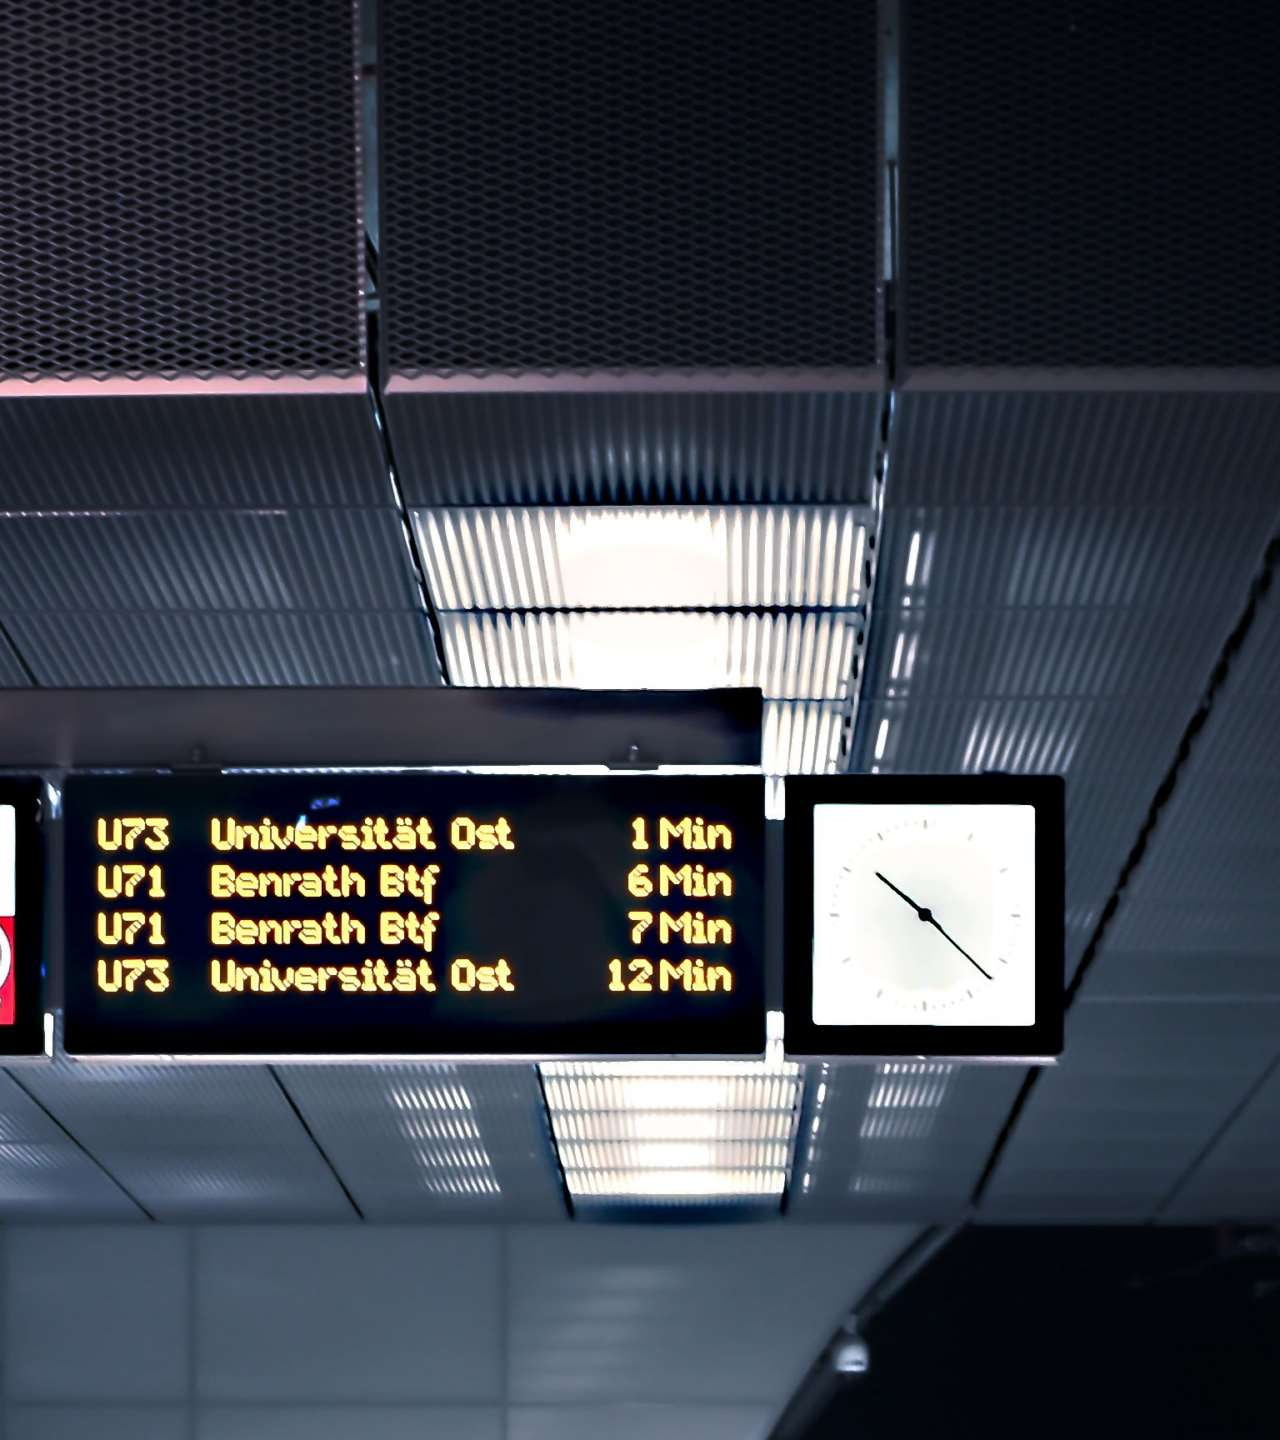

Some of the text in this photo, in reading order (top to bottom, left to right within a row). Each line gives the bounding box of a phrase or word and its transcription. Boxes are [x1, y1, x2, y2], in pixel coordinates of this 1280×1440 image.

[97, 817, 733, 850] U73 Universität Ost 1 Min
[97, 864, 733, 905] U71 Benrath Btf 6 Min
[97, 912, 733, 952] U71 Benrath Btf 7 Min
[97, 959, 733, 992] U73 Universität Ost 12 Min
